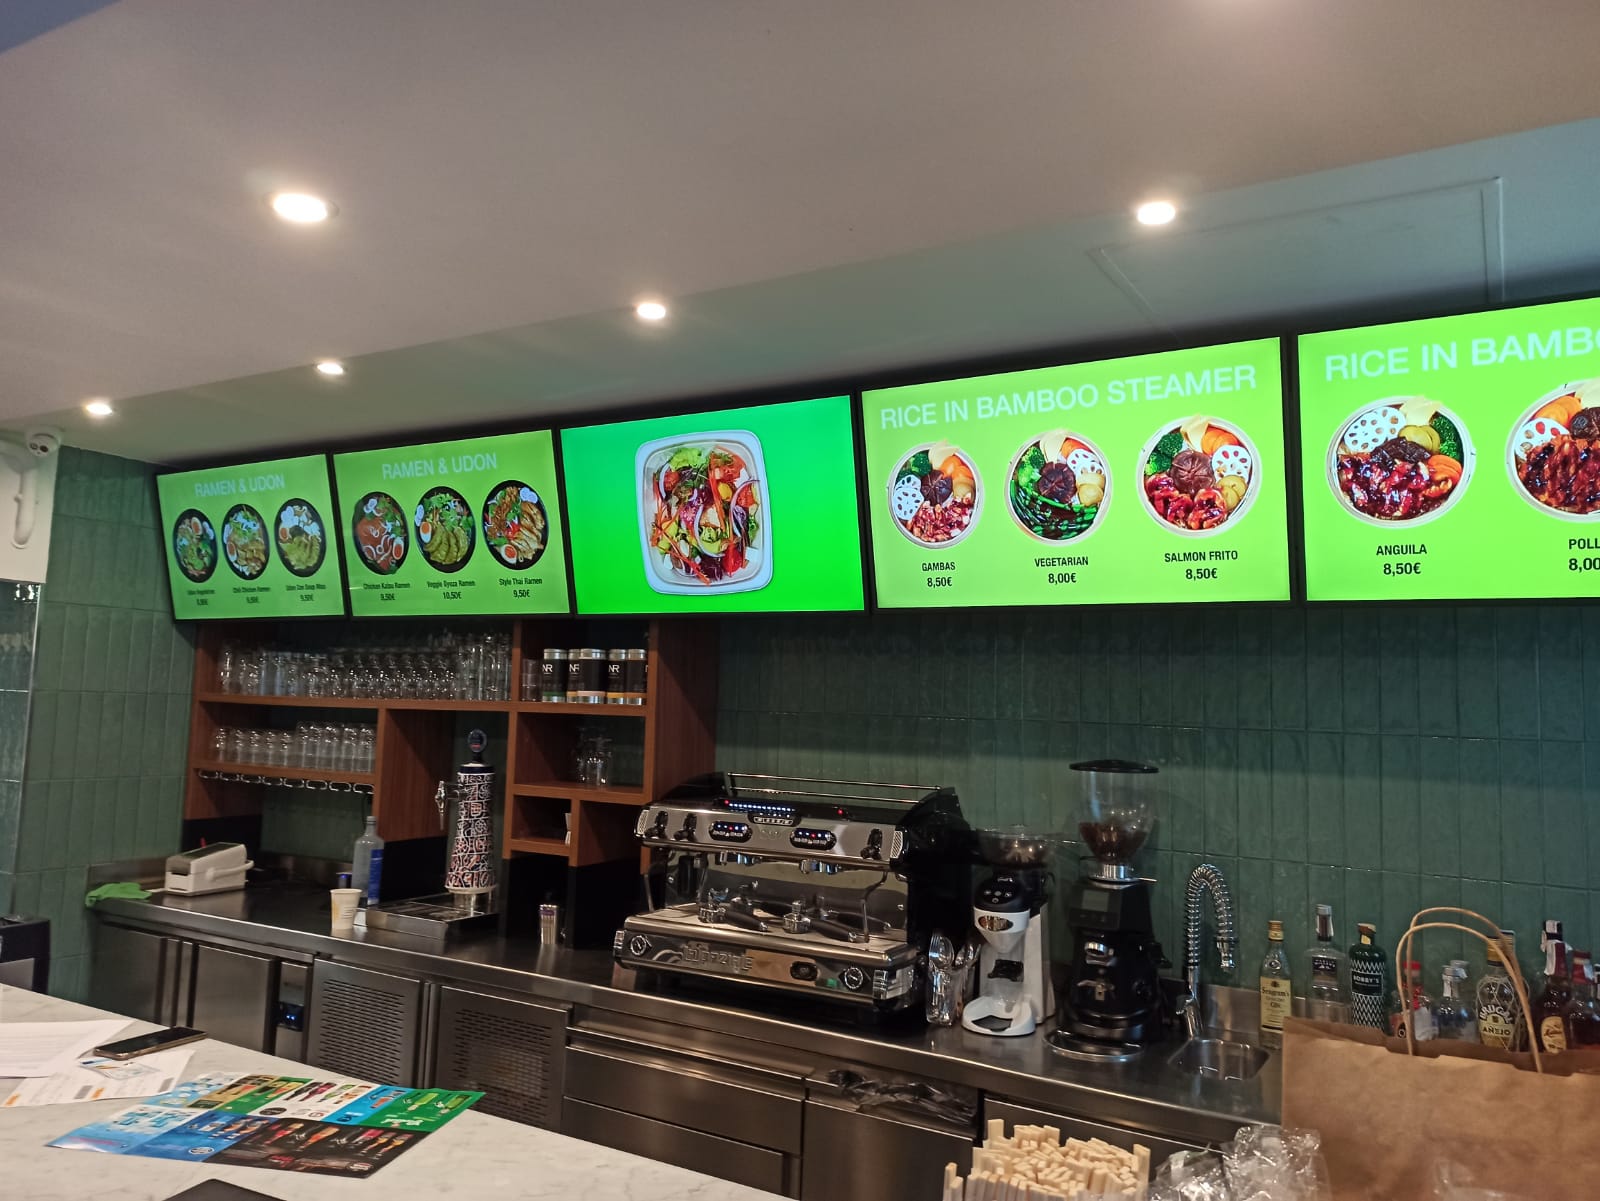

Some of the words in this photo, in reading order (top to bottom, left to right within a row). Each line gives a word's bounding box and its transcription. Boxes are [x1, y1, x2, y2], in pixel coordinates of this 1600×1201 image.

[1325, 347, 1410, 382] RICE
[1421, 341, 1458, 372] IN
[1471, 326, 1600, 366] BAMB
[880, 403, 937, 429] RICE
[944, 399, 969, 423] IN
[977, 383, 1099, 420] BAMBOO
[1106, 364, 1257, 404] STEAMER
[382, 459, 434, 480] RAMEN
[439, 457, 448, 474] &
[452, 452, 497, 473] UDON
[194, 479, 235, 497] RAMEN
[239, 477, 246, 493] &
[249, 474, 285, 492] UDON
[1164, 550, 1206, 563] SALMON
[1209, 550, 1238, 561] FRITO
[1376, 544, 1427, 556] ANGUILA
[921, 561, 956, 572] GAMBAS
[1034, 556, 1089, 568] VEGETARIAN
[1185, 567, 1218, 581] 8,50€
[1383, 562, 1421, 576] 8,50€
[512, 577, 523, 585] Thai
[524, 577, 542, 585] Ramen
[926, 576, 953, 589] 8,50€
[1048, 572, 1077, 585] 8,00€
[443, 591, 462, 600] 10,50€
[513, 589, 531, 599] 9,50€
